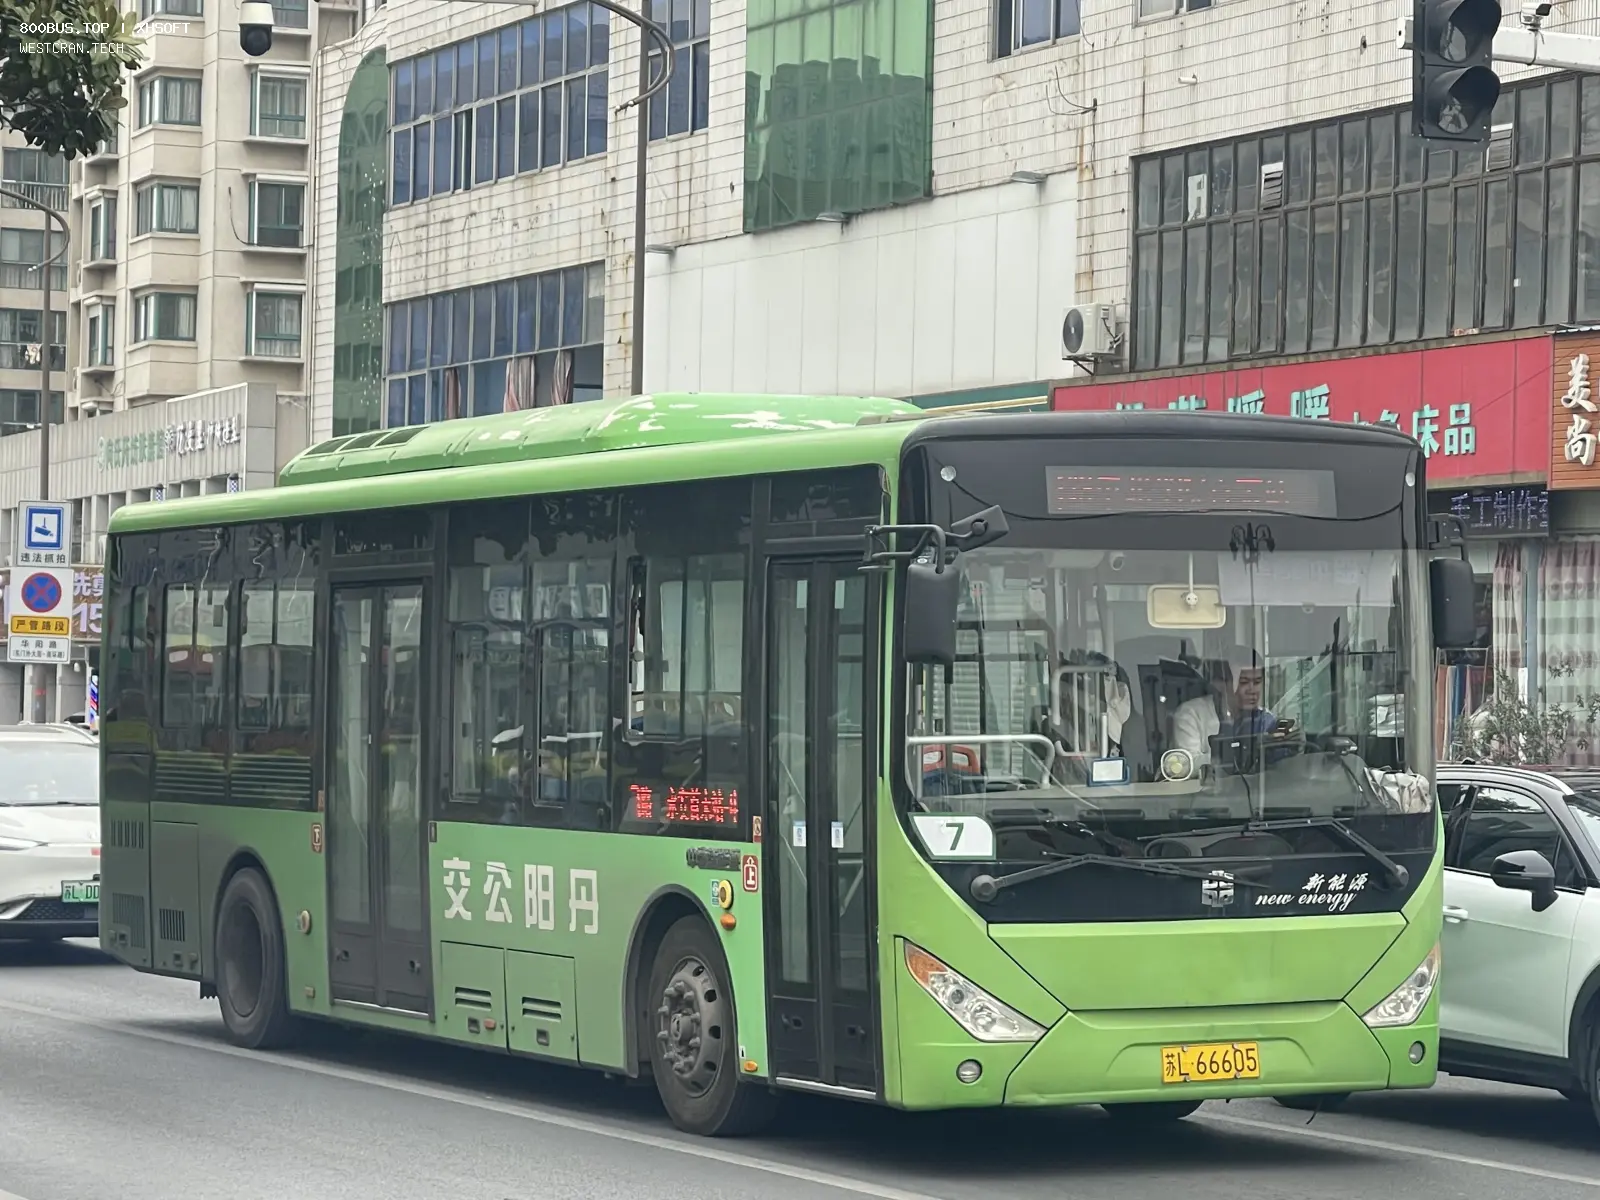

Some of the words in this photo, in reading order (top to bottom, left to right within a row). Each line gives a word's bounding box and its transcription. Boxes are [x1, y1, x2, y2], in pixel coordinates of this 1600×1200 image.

[20, 552, 66, 563] 违法抓拍
[16, 619, 65, 632] 严管路段
[945, 822, 965, 851] 7
[1302, 872, 1369, 893] 新能源
[1255, 892, 1295, 906] new
[1298, 890, 1358, 912] energy
